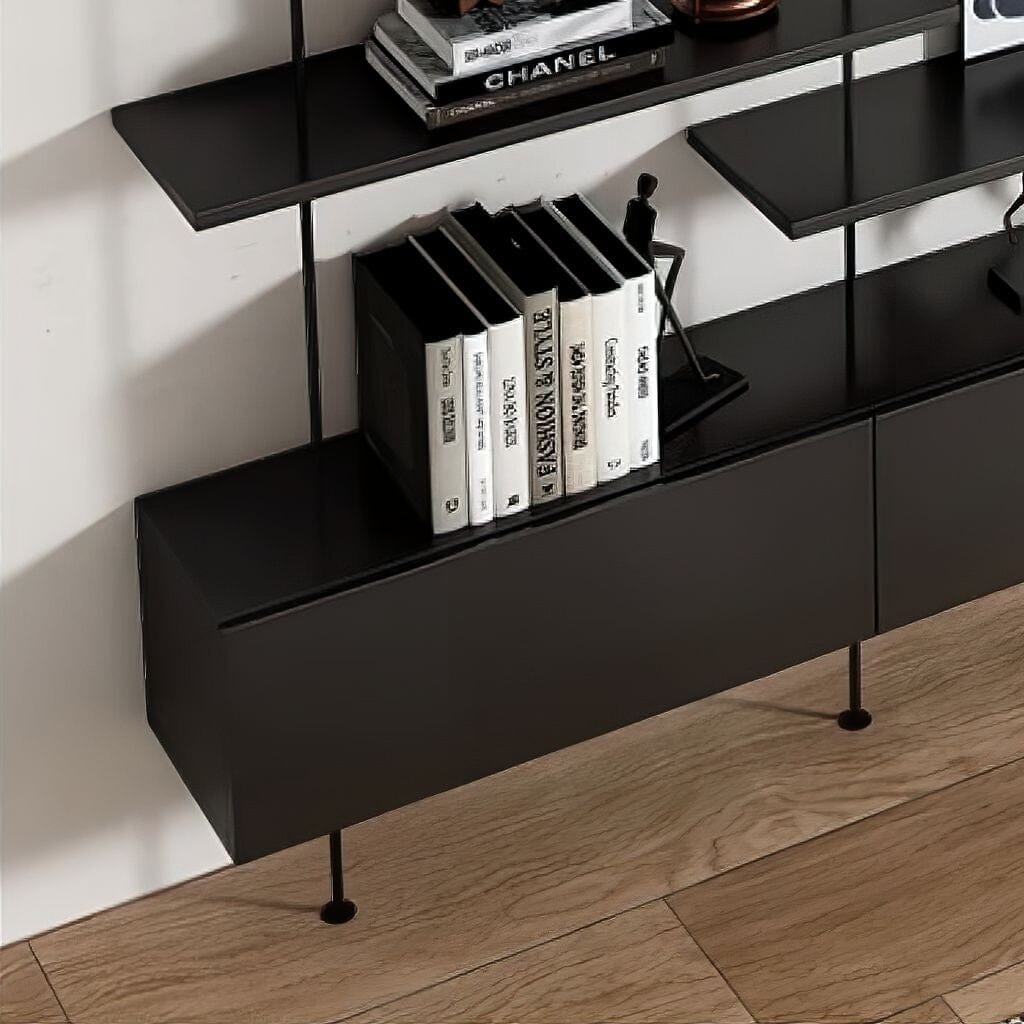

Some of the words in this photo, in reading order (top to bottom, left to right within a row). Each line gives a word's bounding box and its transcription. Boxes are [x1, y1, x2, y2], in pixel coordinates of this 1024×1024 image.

[484, 45, 617, 90] CHANEL
[533, 308, 553, 370] STYLE
[534, 371, 554, 387] &
[534, 391, 555, 477] FASHION
